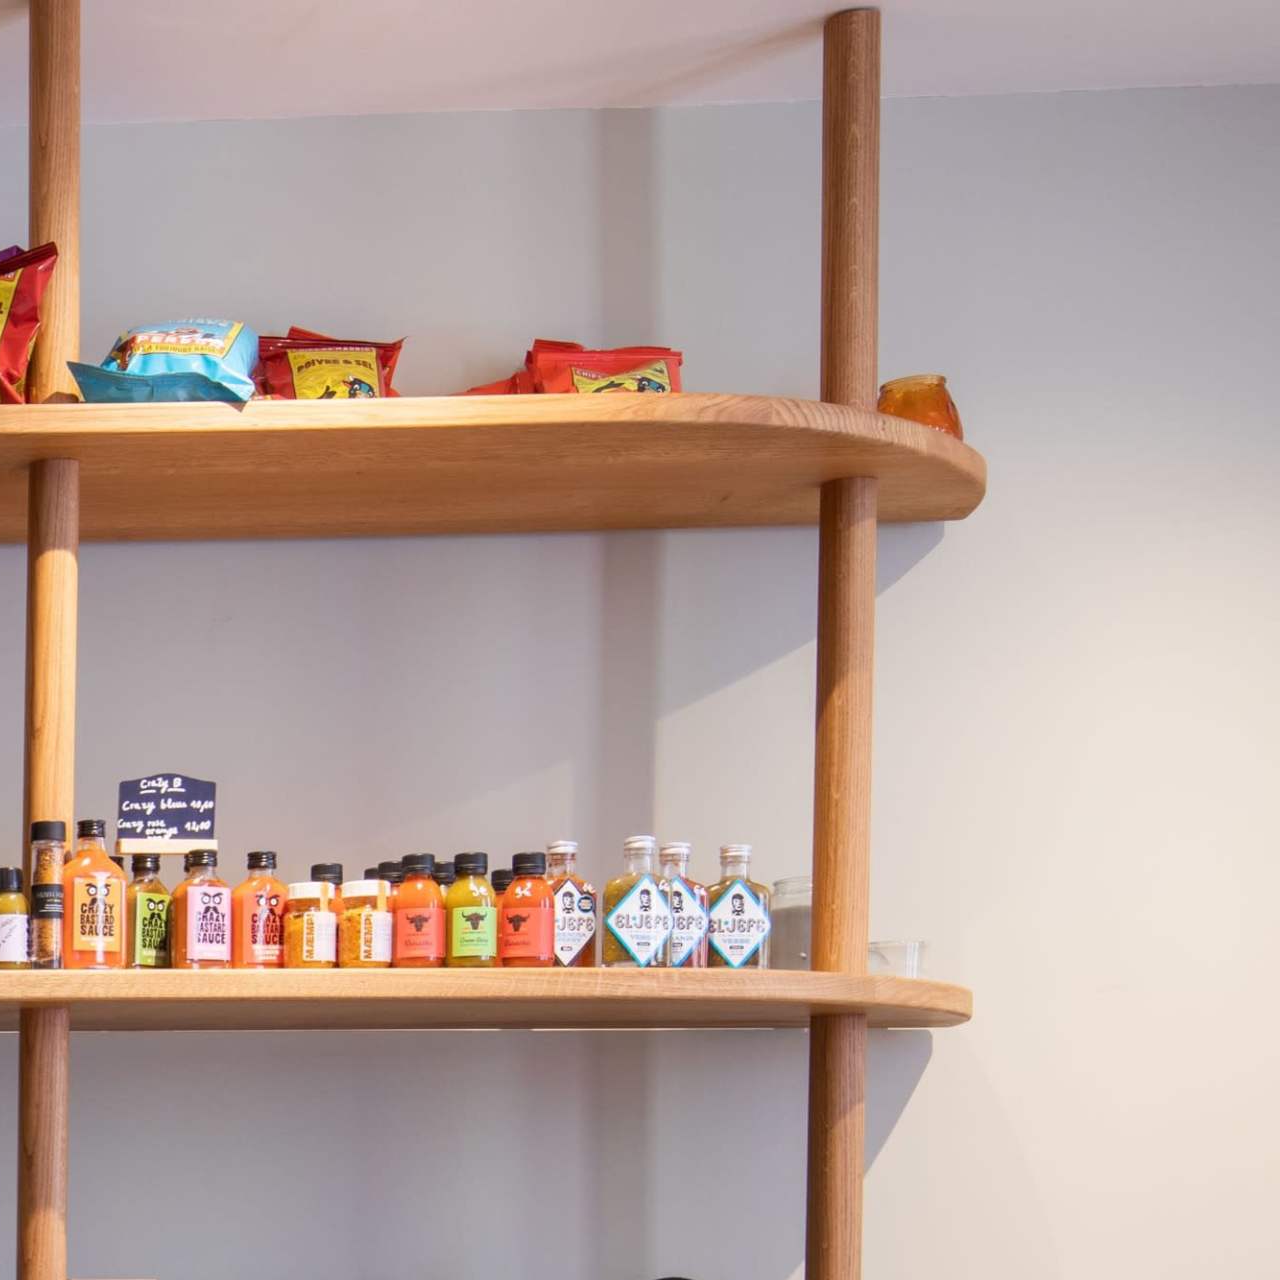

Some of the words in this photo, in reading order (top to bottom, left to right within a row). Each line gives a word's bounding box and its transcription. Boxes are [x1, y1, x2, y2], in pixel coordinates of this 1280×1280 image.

[354, 359, 375, 371] SEL
[140, 777, 169, 794] Crazy
[122, 800, 156, 815] Crazy
